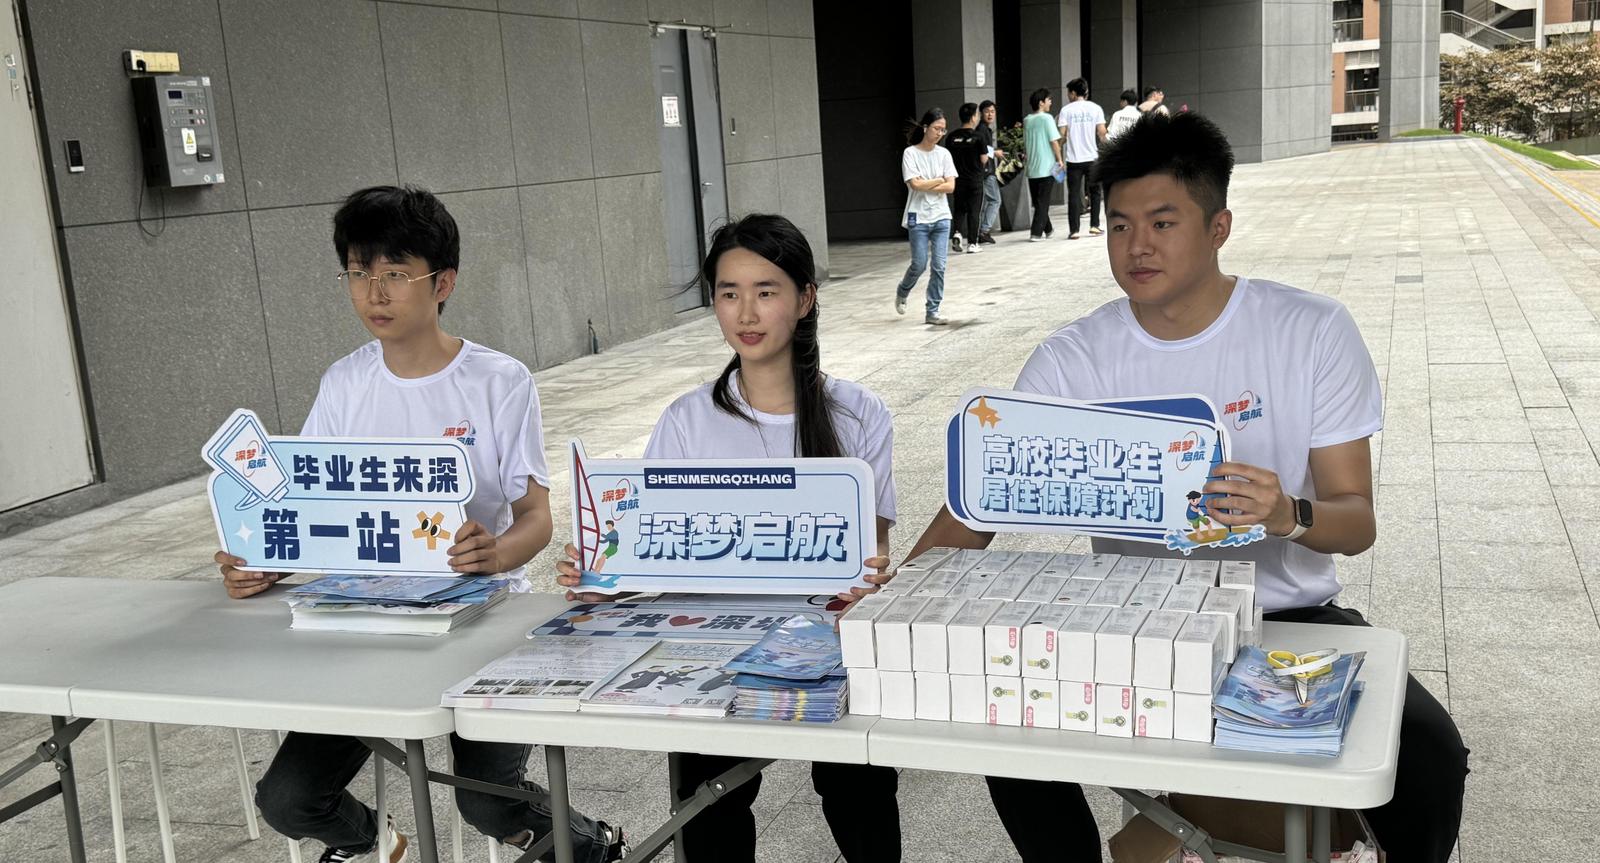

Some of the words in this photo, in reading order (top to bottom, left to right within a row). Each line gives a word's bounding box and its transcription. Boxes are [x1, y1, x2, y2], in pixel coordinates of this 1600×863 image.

[1224, 399, 1249, 415] 深梦
[1239, 408, 1262, 422] 启航
[1168, 440, 1194, 453] 深梦
[235, 449, 257, 461] 深梦
[983, 434, 1163, 484] 高校毕业生
[1181, 451, 1206, 462] 启航
[247, 458, 267, 469] 启航
[293, 455, 459, 493] 毕业生来深
[647, 473, 793, 486] SHENMENGQIHANG
[601, 488, 627, 502] 深梦
[980, 477, 1163, 522] 居住保障计划
[616, 499, 640, 511] 启航
[262, 508, 401, 563] 第一站
[634, 512, 848, 562] 深梦启航
[617, 613, 670, 628] 我
